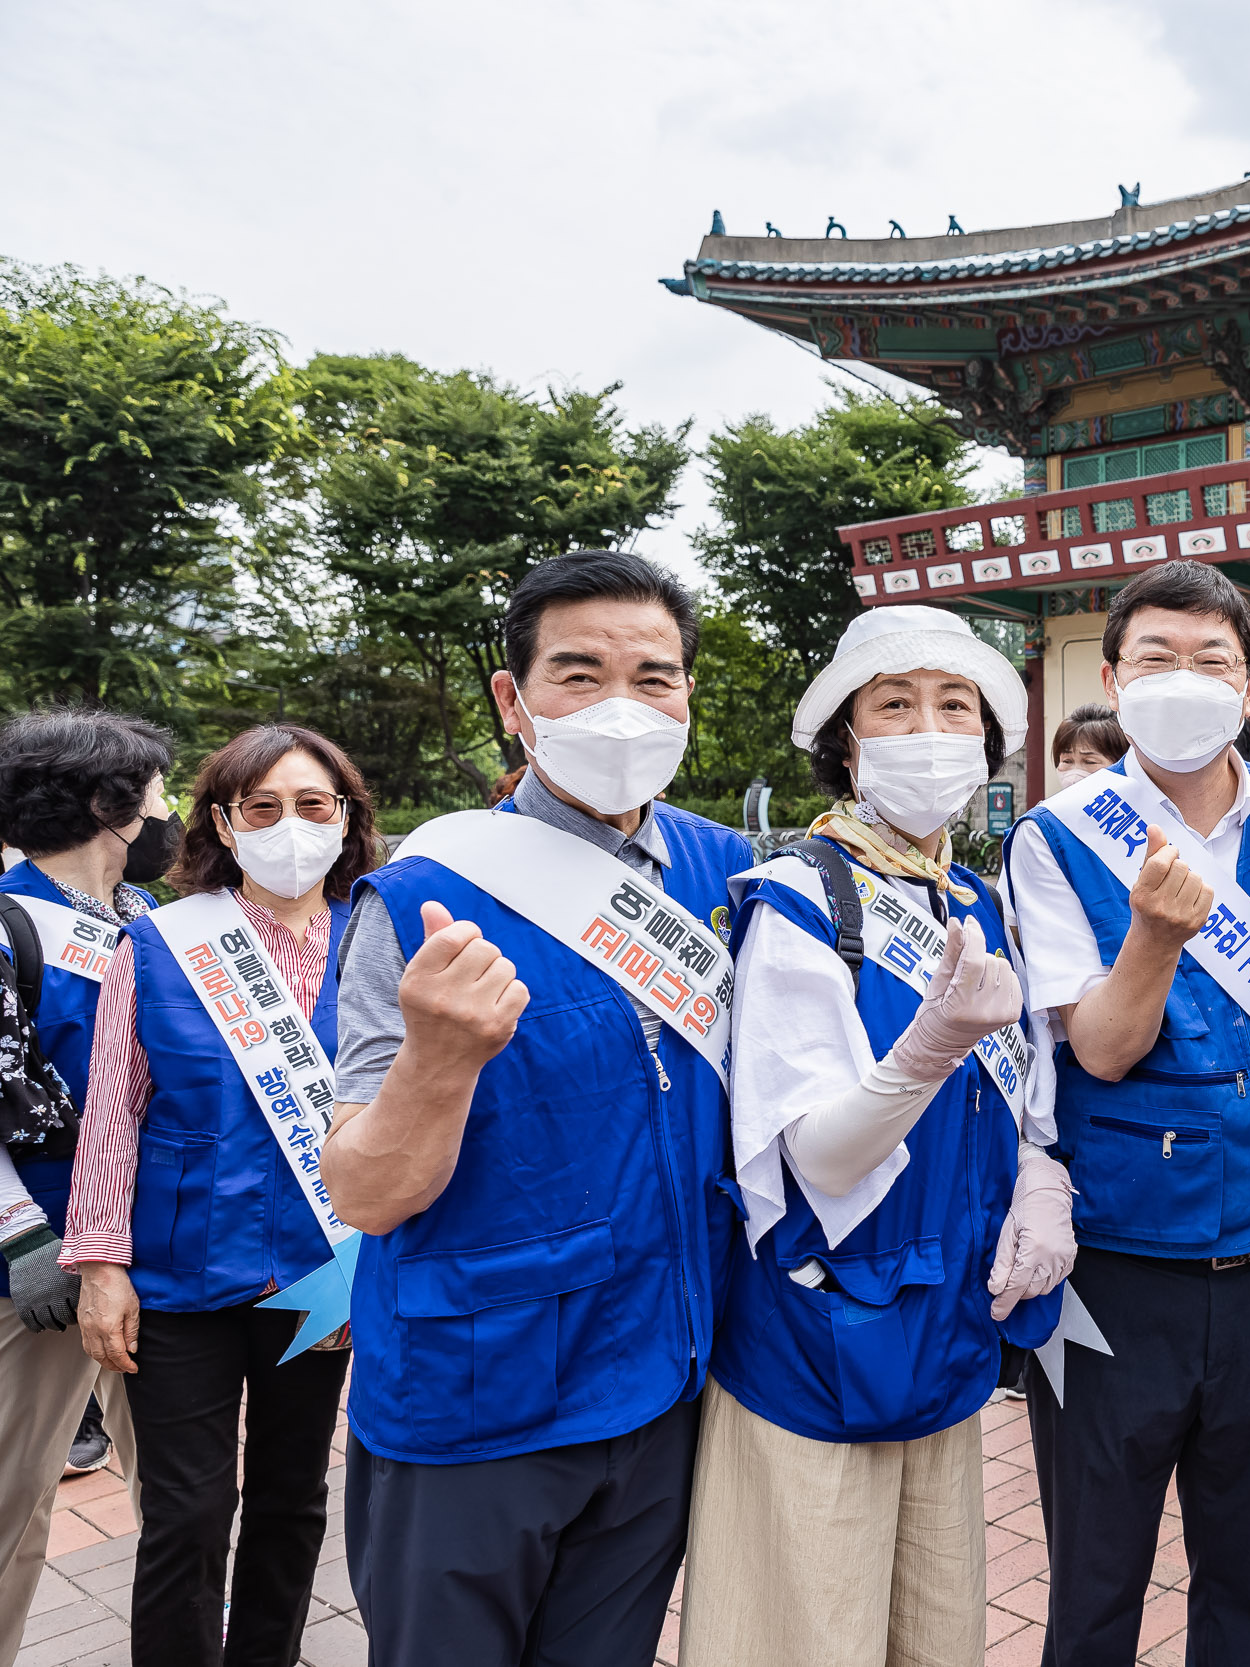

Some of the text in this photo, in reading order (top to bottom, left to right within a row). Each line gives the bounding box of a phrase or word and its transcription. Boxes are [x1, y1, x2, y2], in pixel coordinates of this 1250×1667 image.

[580, 916, 716, 1036] 코로나19
[610, 882, 717, 977] 여름철
[184, 942, 266, 1048] 코로나19
[220, 928, 284, 1009] 여름철
[269, 1014, 316, 1069] 행락
